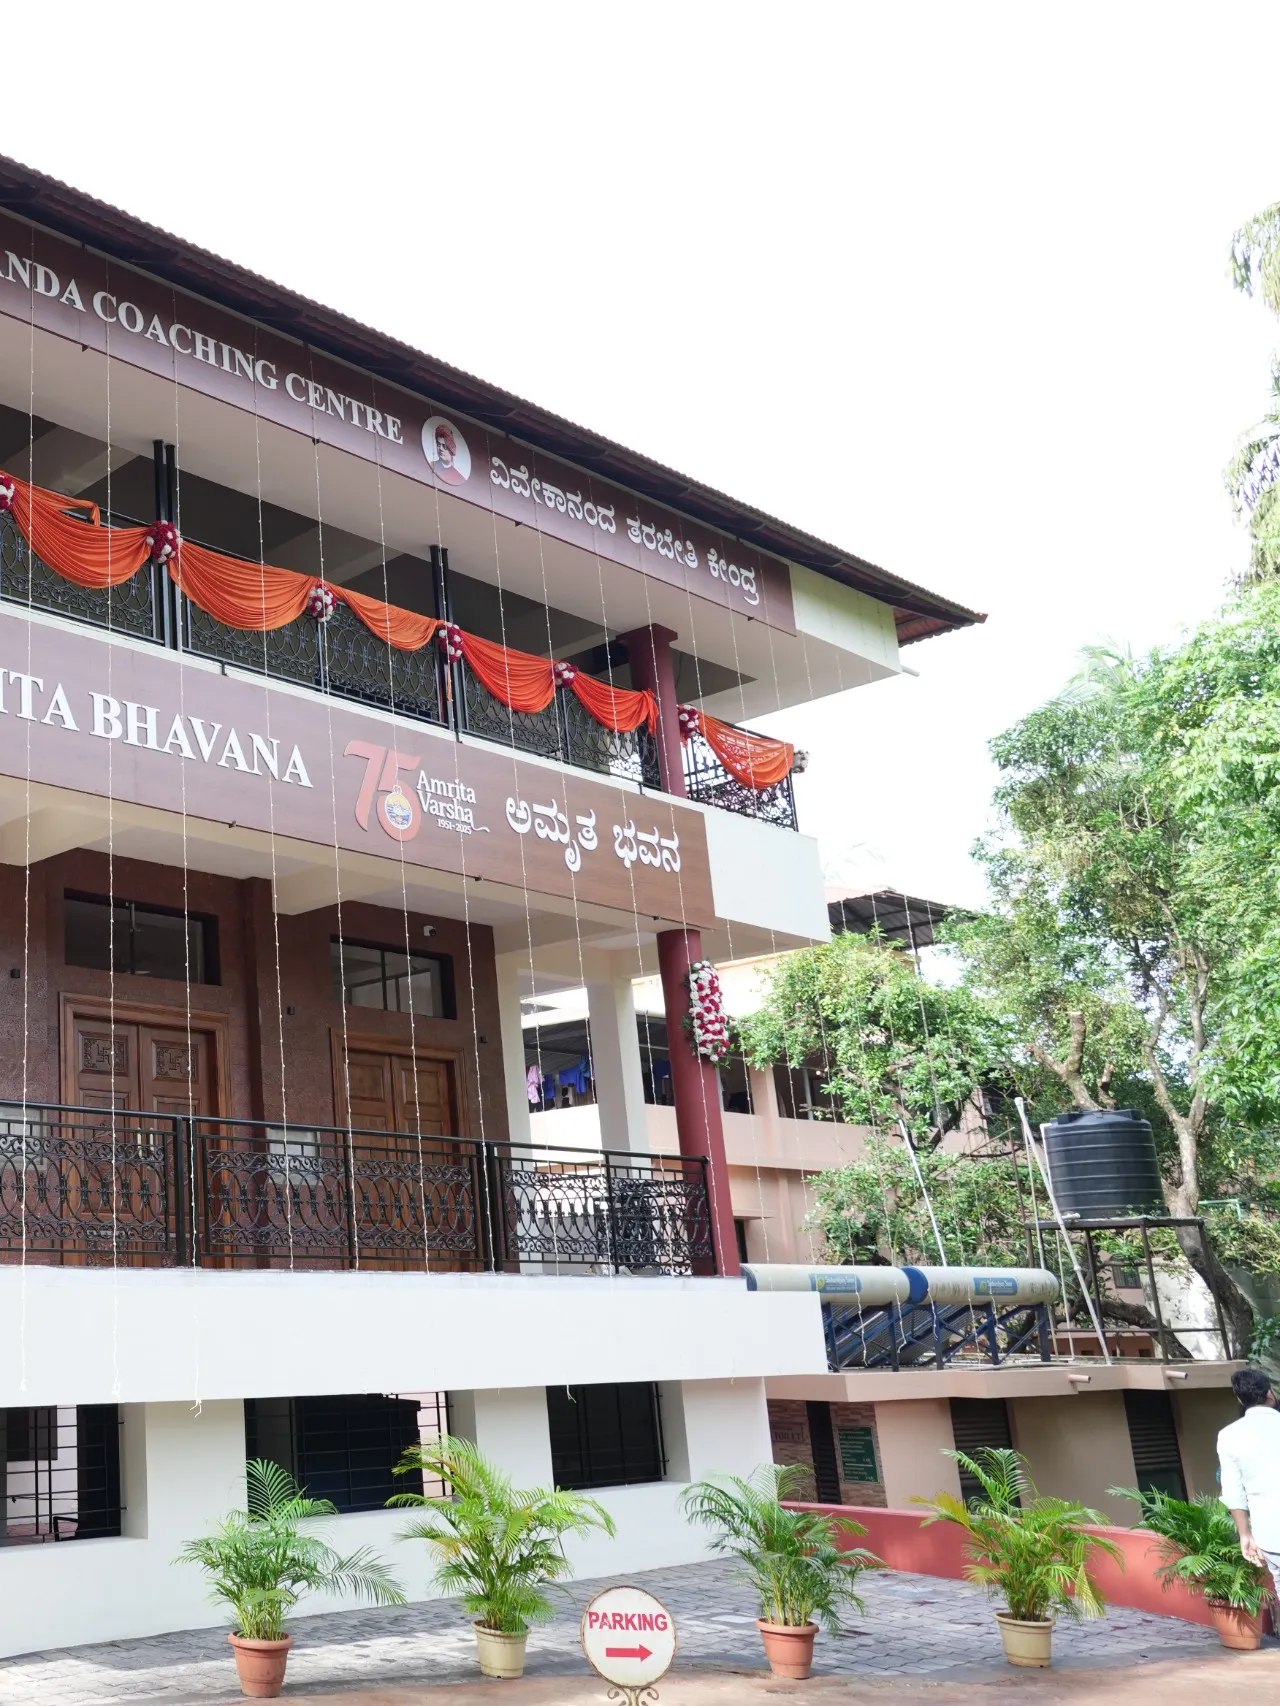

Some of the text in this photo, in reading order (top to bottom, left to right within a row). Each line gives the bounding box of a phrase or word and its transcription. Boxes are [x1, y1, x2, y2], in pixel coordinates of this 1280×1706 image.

[93, 291, 278, 390] COACHING
[285, 372, 404, 446] CENTRE
[490, 456, 760, 606] ವಿವೇಕಾನಂದ ತರಬೇತಿ ಕೇಂದ್ರ
[88, 691, 314, 788] BHAVANA
[343, 740, 422, 842] 75
[417, 769, 476, 804] Amrita
[417, 789, 488, 832] Varsha
[505, 797, 682, 873] ಅಮೃತ ಭವನ
[588, 1611, 668, 1631] PARKING
